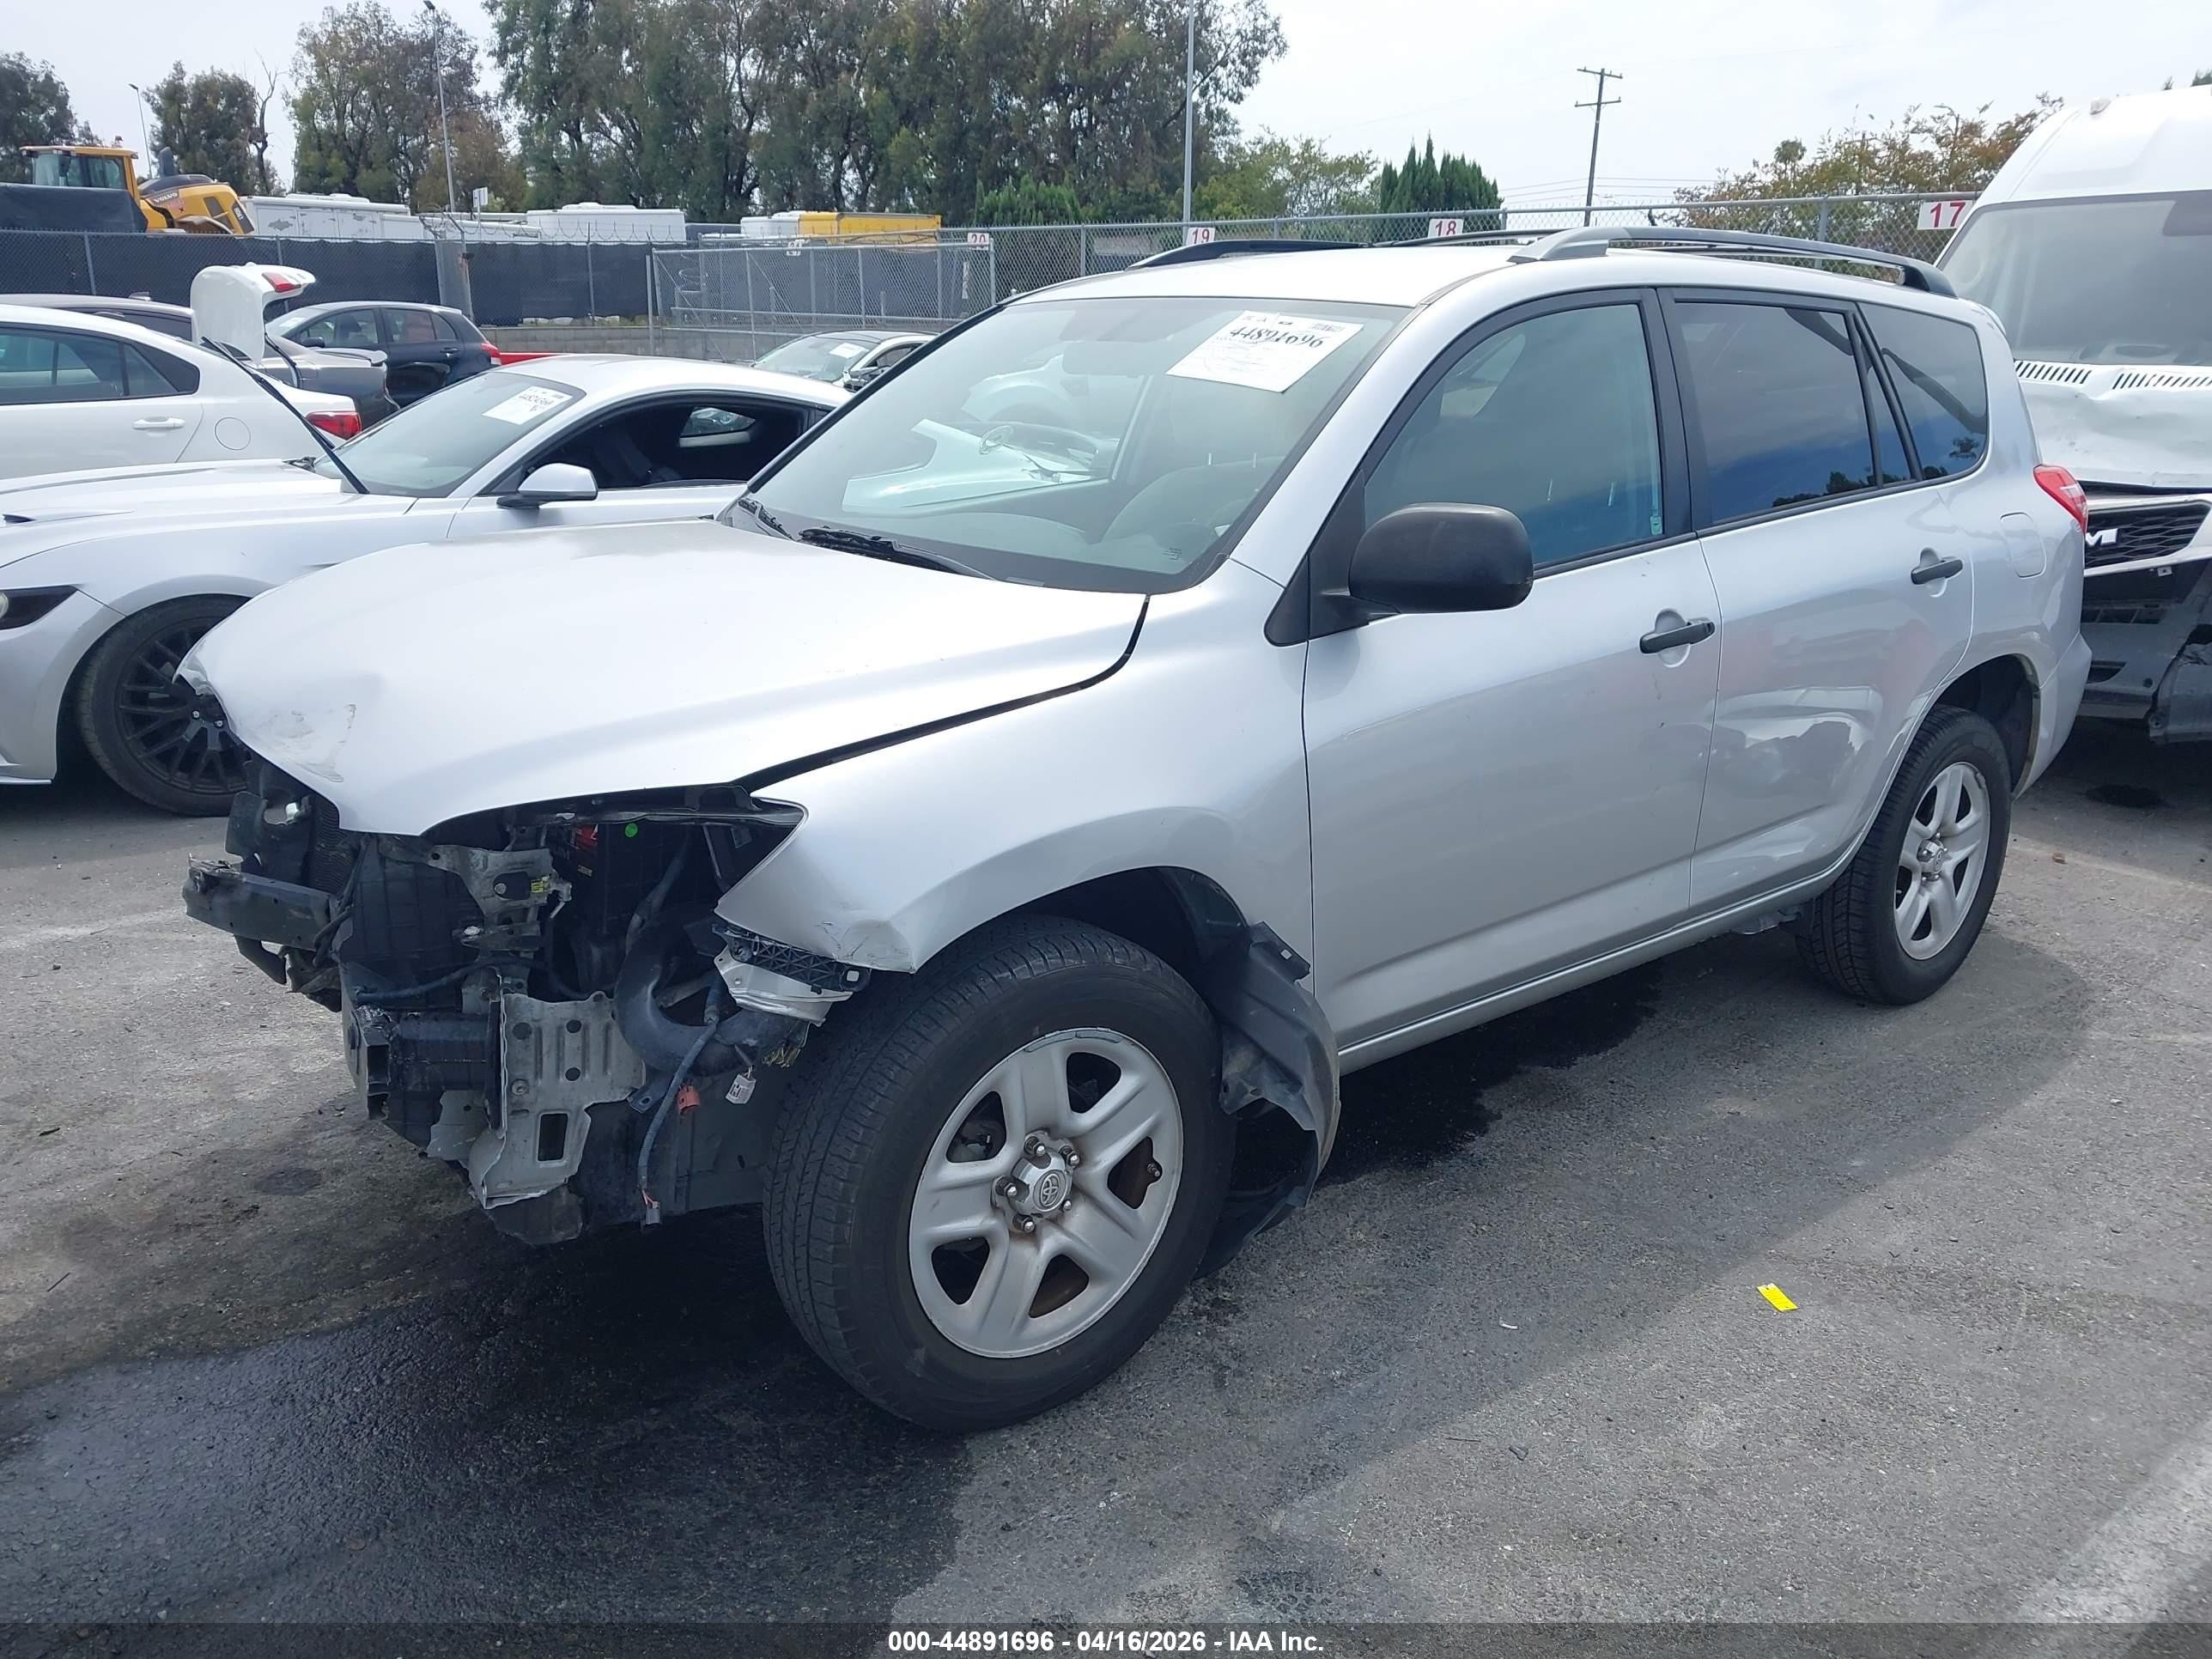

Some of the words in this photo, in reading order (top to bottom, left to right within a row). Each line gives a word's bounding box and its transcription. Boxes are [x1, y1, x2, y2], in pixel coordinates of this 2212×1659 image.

[154, 192, 178, 204] VOLVO
[1930, 202, 1966, 228] 17
[1192, 228, 1210, 244] 19
[1435, 220, 1457, 236] 18
[1230, 325, 1331, 348] 44891696
